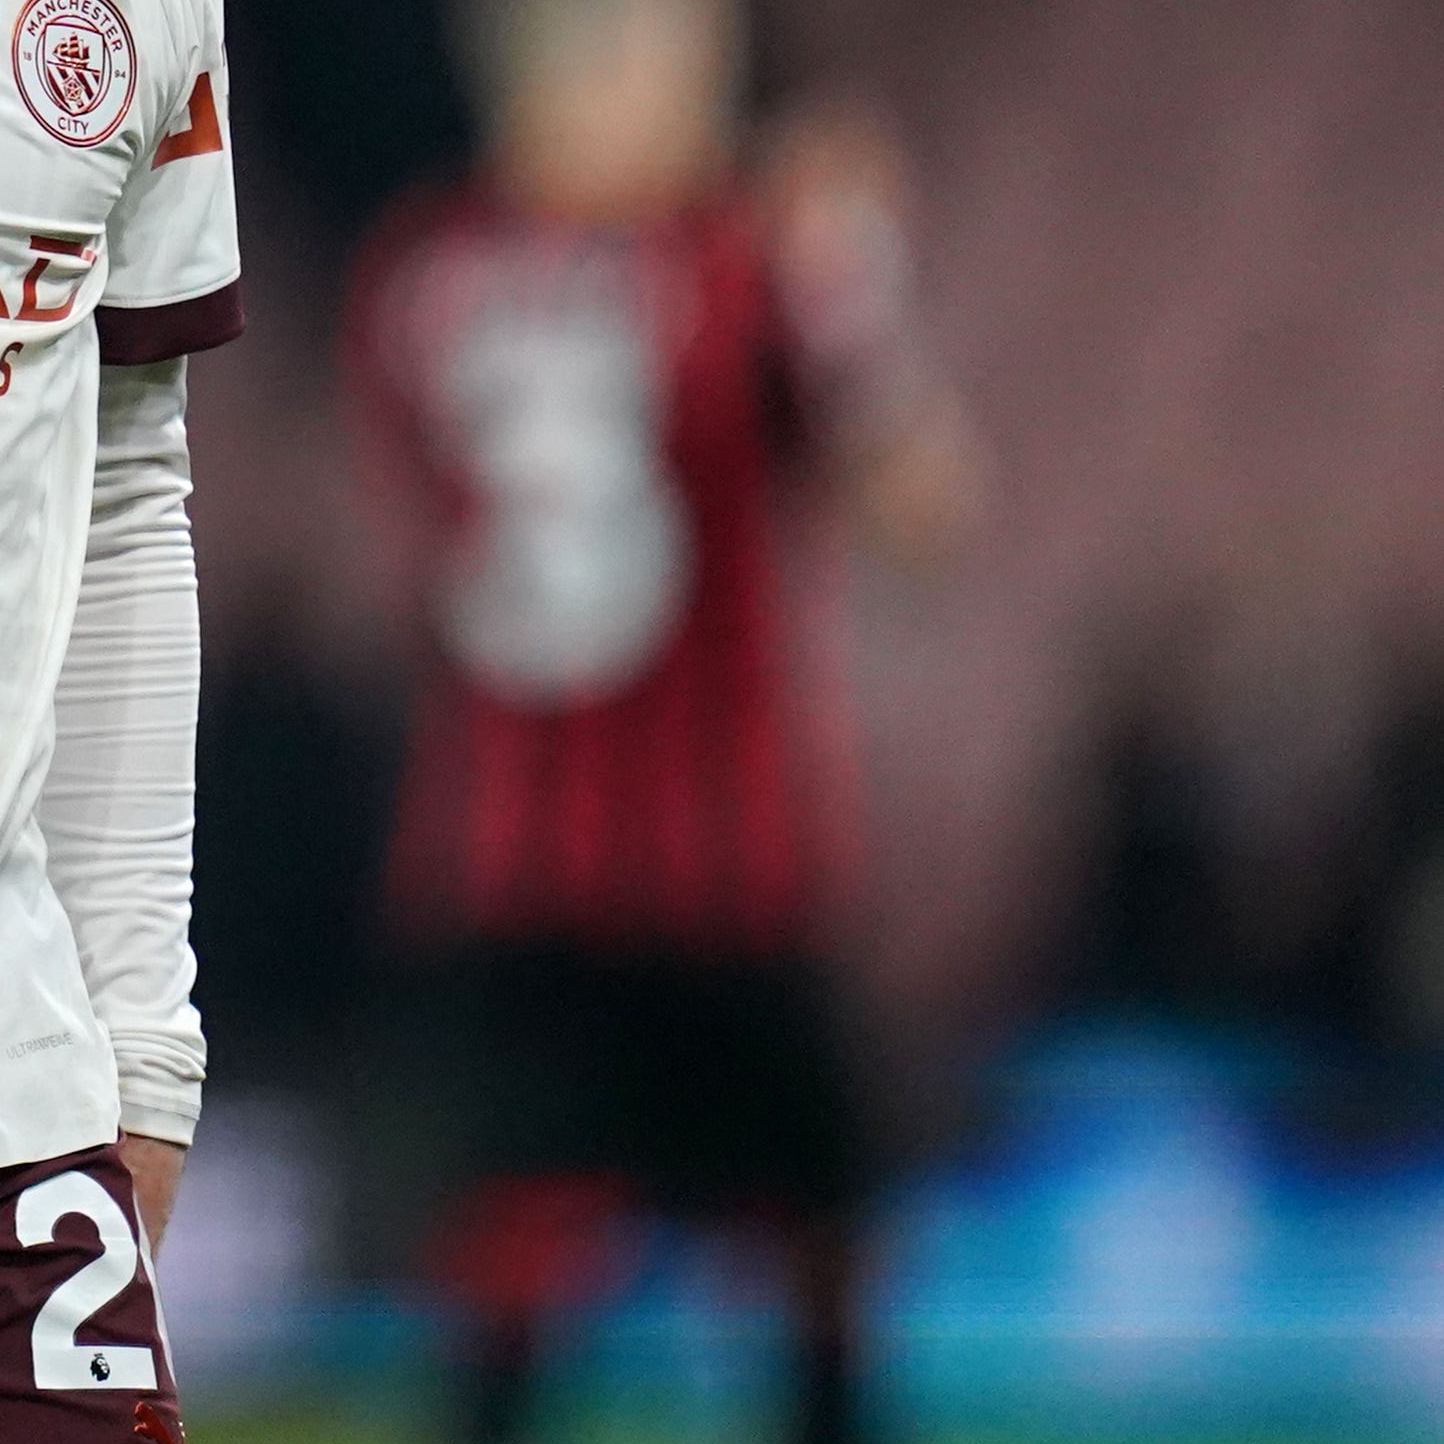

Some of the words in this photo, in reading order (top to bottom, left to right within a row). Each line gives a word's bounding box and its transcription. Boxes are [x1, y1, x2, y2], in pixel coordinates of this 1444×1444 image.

[114, 69, 126, 79] 94
[57, 117, 90, 135] CITY
[15, 1170, 158, 1390] 2
